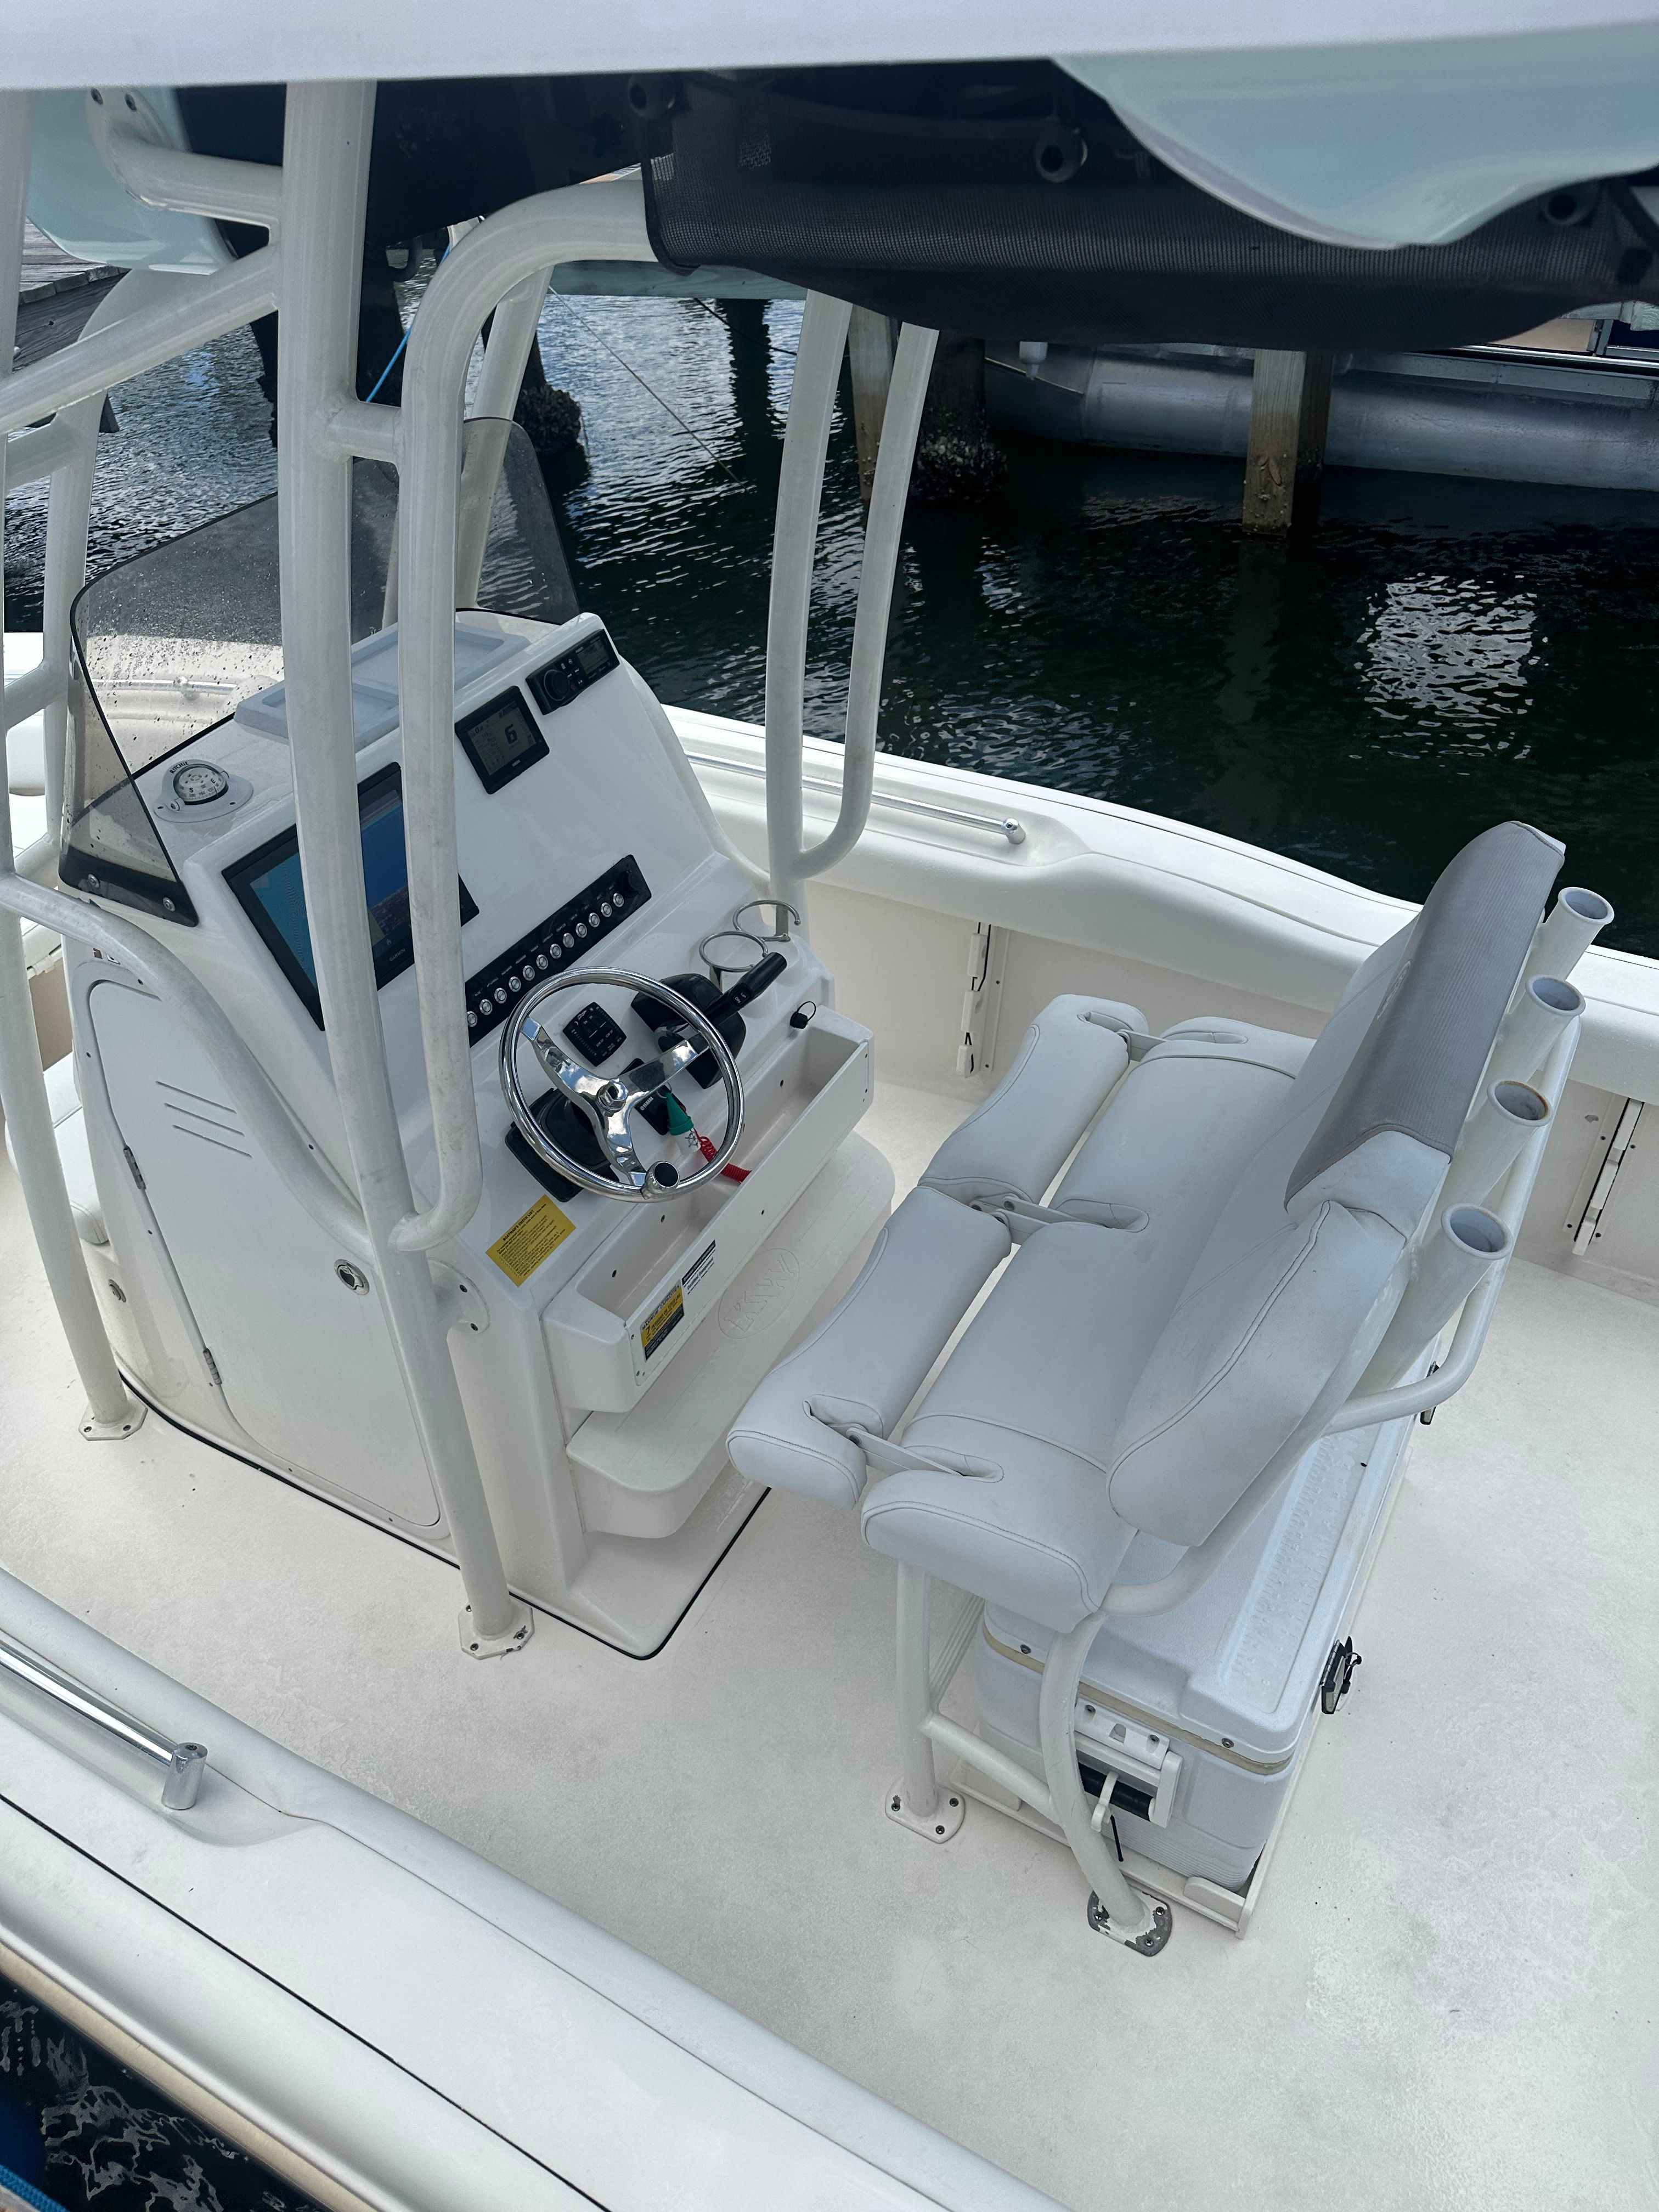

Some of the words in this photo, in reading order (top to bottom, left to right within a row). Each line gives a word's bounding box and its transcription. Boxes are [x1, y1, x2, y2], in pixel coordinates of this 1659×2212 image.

[505, 724, 517, 744] 6
[170, 761, 189, 774] RITCHIE
[390, 948, 405, 961] GARMIN
[642, 1096, 654, 1108] YAMAHA
